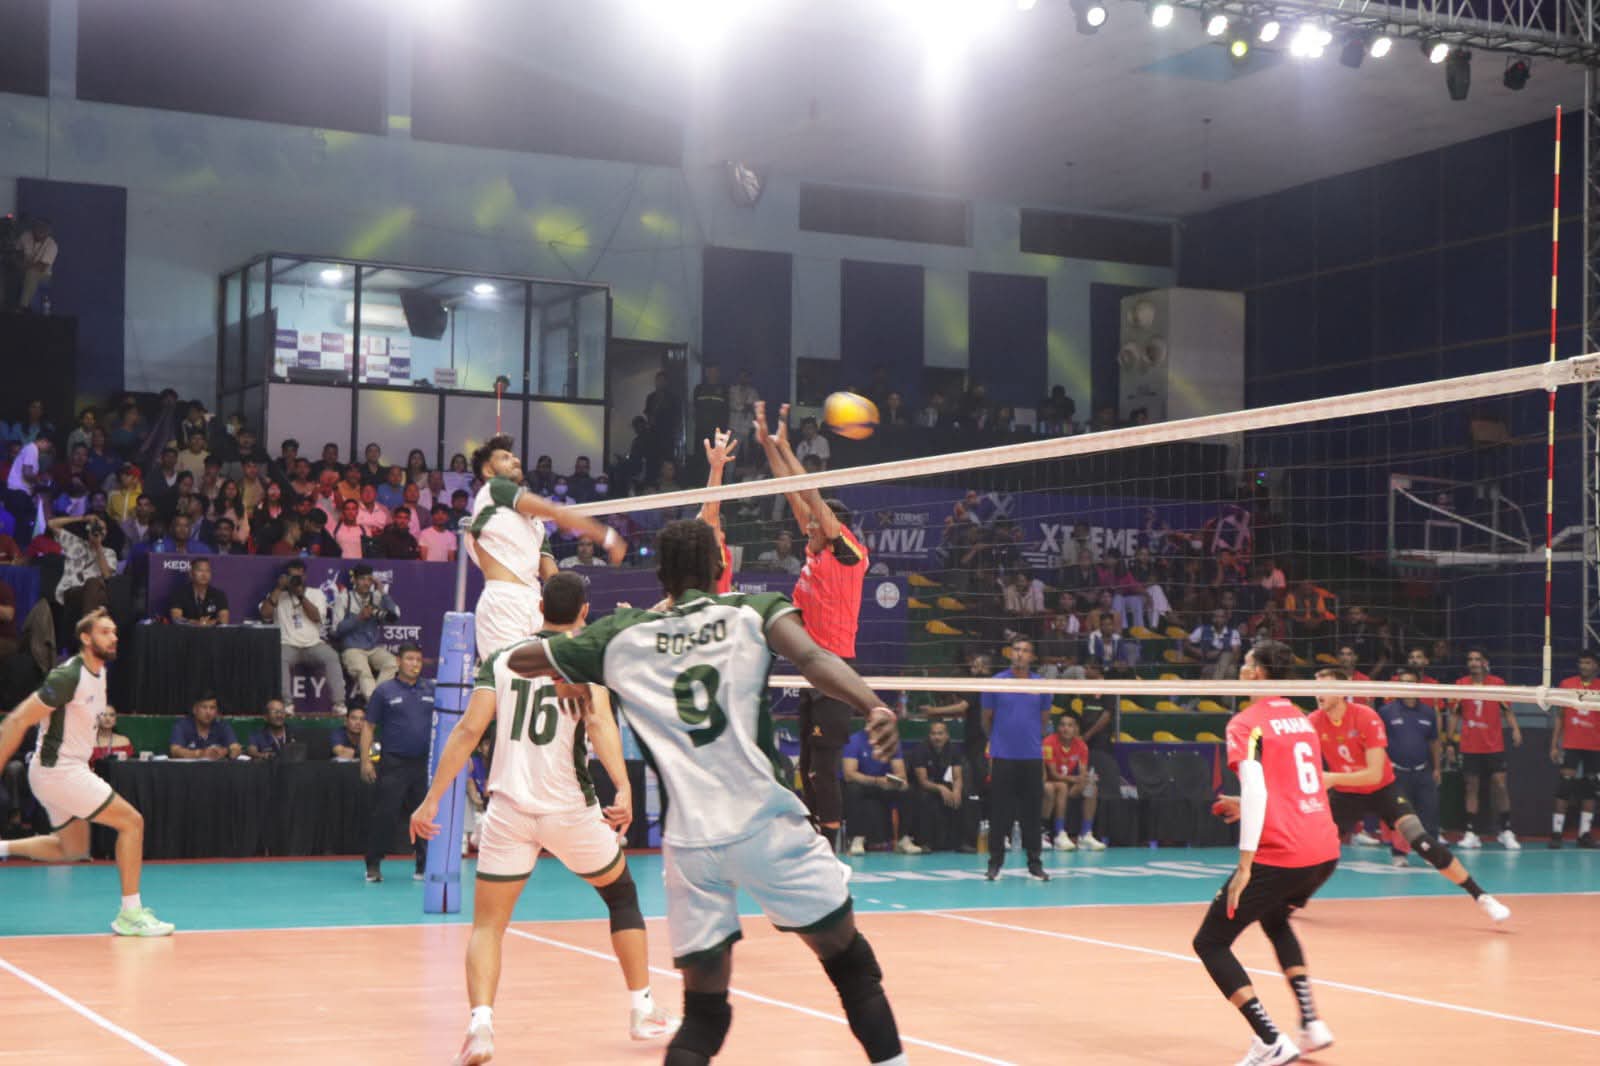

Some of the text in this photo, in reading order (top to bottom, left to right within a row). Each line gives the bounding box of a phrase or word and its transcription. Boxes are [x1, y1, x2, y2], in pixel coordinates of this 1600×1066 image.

[879, 529, 928, 552] NVL
[1039, 522, 1139, 558] XTEME
[510, 678, 558, 746] 16
[673, 664, 728, 748] 9
[1293, 741, 1320, 795] 6
